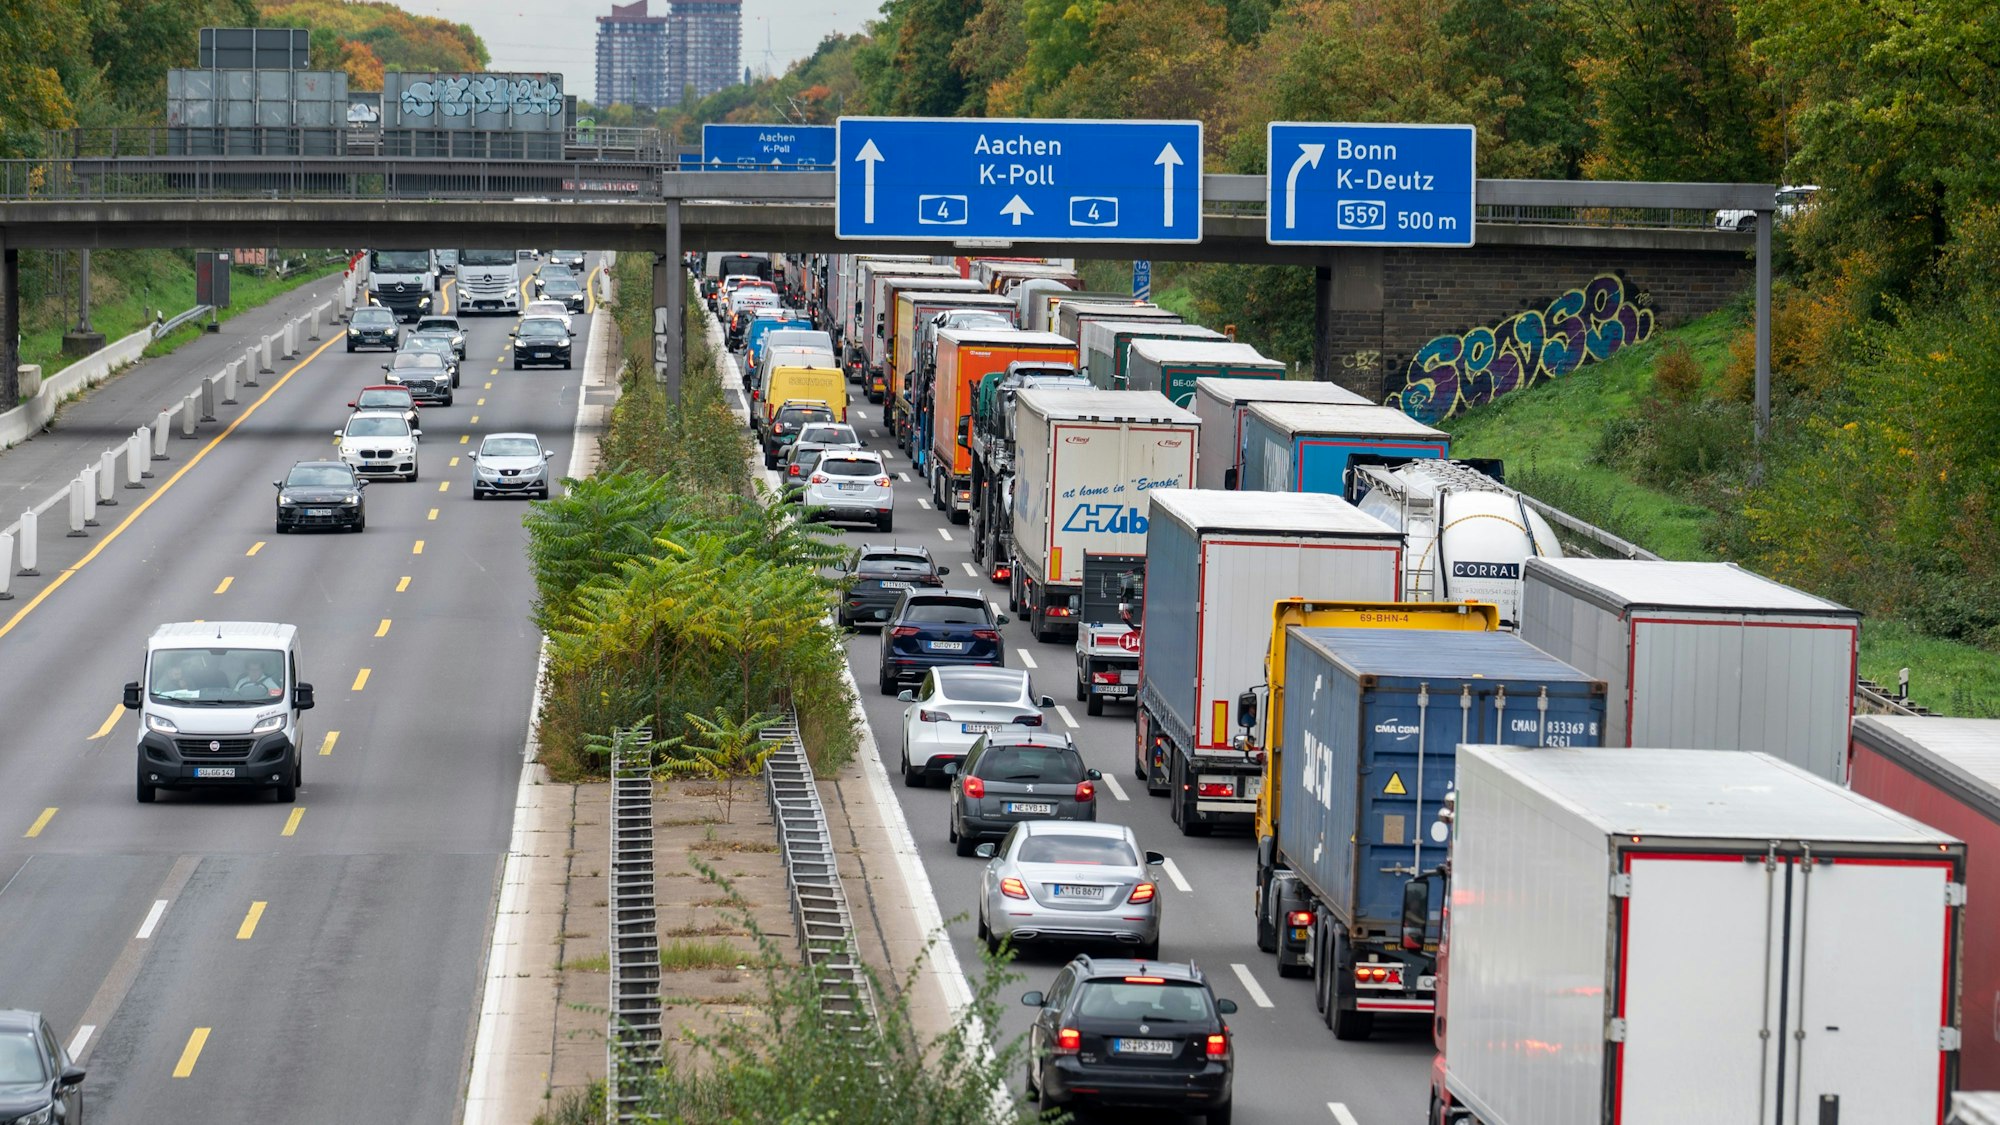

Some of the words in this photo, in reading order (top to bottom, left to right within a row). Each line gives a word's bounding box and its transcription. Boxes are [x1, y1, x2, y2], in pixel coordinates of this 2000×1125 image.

[759, 132, 795, 142] Aachen
[763, 145, 790, 153] K-Poll
[974, 134, 1062, 156] Aachen
[1337, 139, 1397, 160] Bonn
[979, 164, 1055, 186] K-Poll
[1337, 169, 1435, 191] K-Deutz
[937, 201, 949, 219] 4
[1087, 203, 1100, 221] 4
[1344, 206, 1379, 224] 559
[1398, 211, 1434, 230] 500
[1438, 216, 1457, 230] m
[1172, 379, 1197, 387] BE-02
[1062, 489, 1076, 498] at
[1079, 484, 1109, 496] home
[1113, 484, 1125, 493] in
[1454, 563, 1517, 577] CORRAL
[1360, 613, 1408, 622] 69-BHN-4
[1375, 724, 1397, 733] CMA
[1397, 725, 1419, 734] CGM
[1511, 720, 1537, 733] CMAU
[1547, 721, 1584, 734] 833369
[198, 768, 207, 776] SU
[222, 768, 234, 776] 142
[1060, 886, 1064, 894] K
[1071, 887, 1081, 895] TG
[1082, 887, 1102, 896] 8677
[1120, 1040, 1131, 1049] HS
[1139, 1041, 1149, 1050] PS
[1151, 1041, 1171, 1052] 1993
